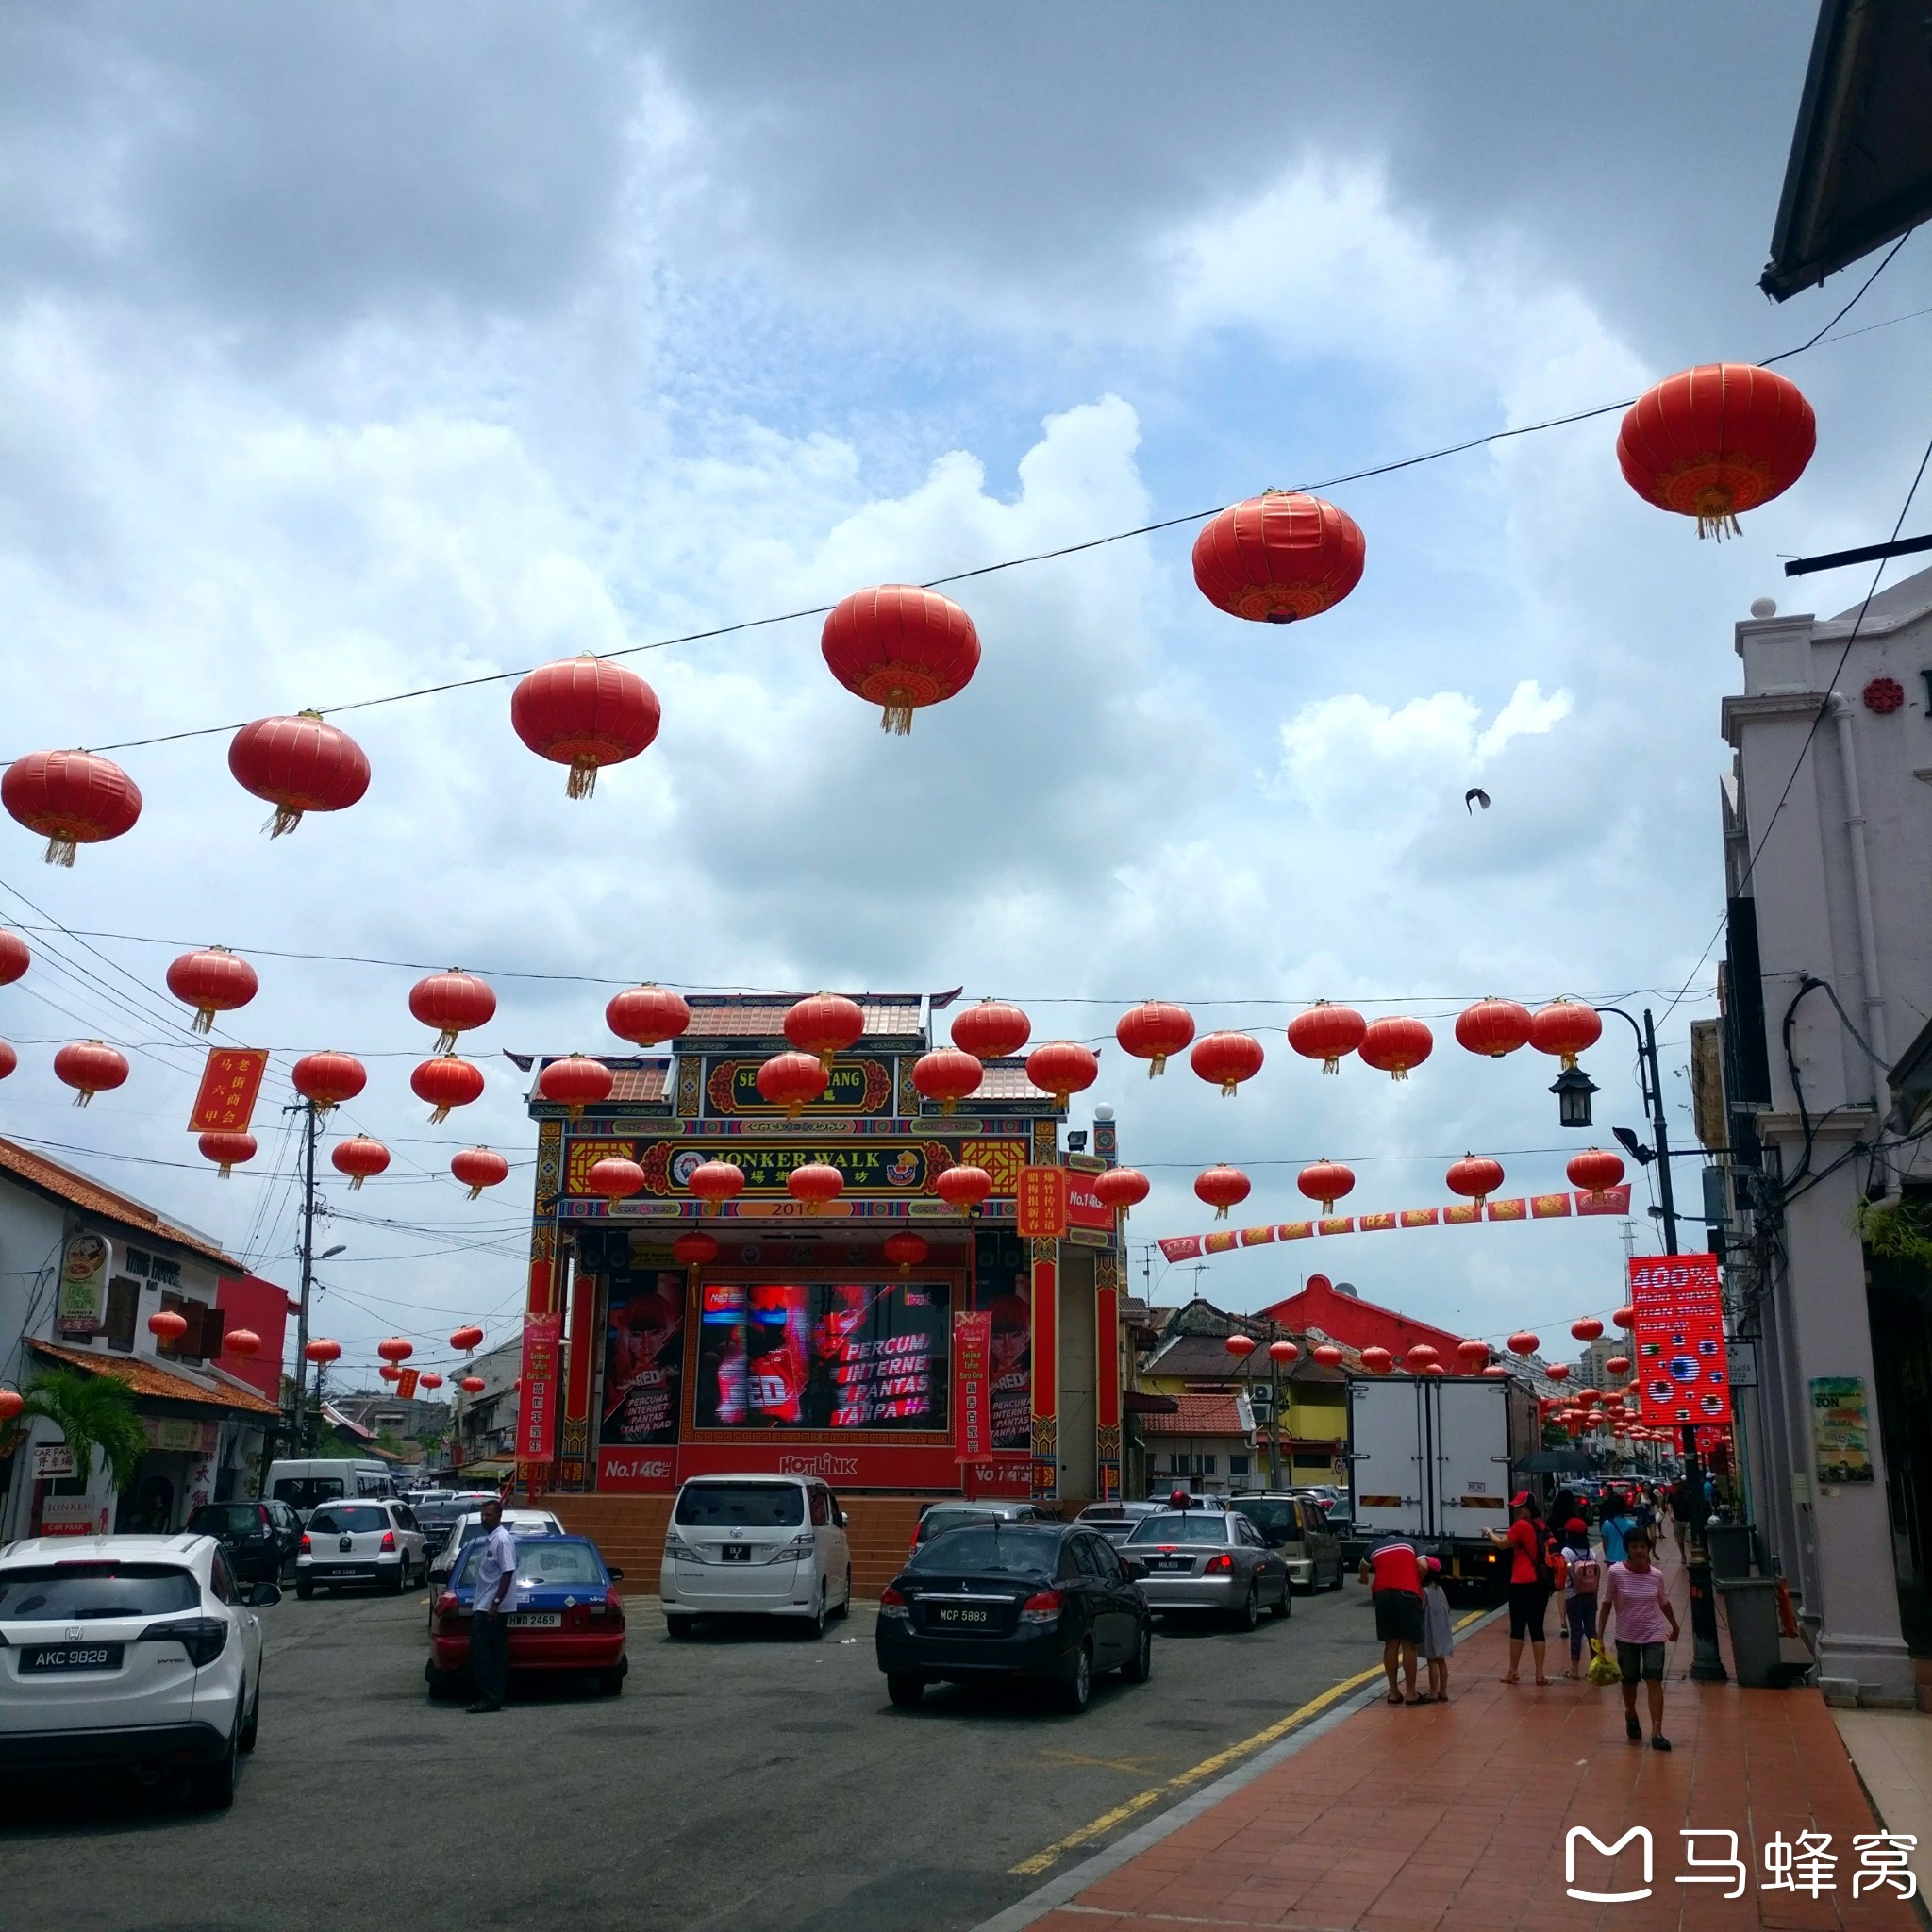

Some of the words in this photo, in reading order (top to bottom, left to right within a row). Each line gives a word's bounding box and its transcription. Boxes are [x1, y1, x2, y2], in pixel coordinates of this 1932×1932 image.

[827, 1072, 860, 1086] TANG
[205, 1058, 233, 1122] 马六甲
[223, 1058, 250, 1123] 老街商会
[713, 1152, 806, 1167] JONKER
[815, 1152, 880, 1167] WALK
[1070, 1191, 1088, 1206] No.1
[1632, 1266, 1716, 1289] 400%
[530, 1352, 551, 1360] Selamat
[962, 1351, 982, 1360] Selamat
[526, 1372, 540, 1380] Baru
[540, 1372, 552, 1380] Cina
[845, 1355, 930, 1383] INTERNE
[959, 1372, 972, 1380] Baru
[972, 1372, 984, 1380] Cina
[636, 1370, 660, 1387] RED
[999, 1373, 1024, 1390] RED
[854, 1374, 928, 1401] PANTAS
[628, 1394, 669, 1406] PERCUMA
[993, 1397, 1031, 1410] PERCUMA
[1814, 1397, 1840, 1407] ZON
[627, 1403, 669, 1415] INTERNET
[838, 1404, 898, 1427] TANPA
[631, 1413, 664, 1424] PANTAS
[996, 1416, 1029, 1428] PANTAS
[624, 1424, 651, 1434] TANPA
[652, 1420, 671, 1429] HAD
[991, 1428, 1016, 1439] TANPA
[1018, 1424, 1030, 1434] HA
[39, 1456, 74, 1467] 停車場
[606, 1461, 638, 1477] No.1
[638, 1462, 662, 1477] 4G
[48, 1503, 91, 1512] JONKER
[509, 1617, 528, 1625] HWD
[531, 1615, 555, 1625] 2469
[940, 1610, 958, 1621] MCP
[961, 1610, 987, 1622] 5883
[35, 1652, 66, 1666] AKC
[69, 1650, 108, 1663] 9828
